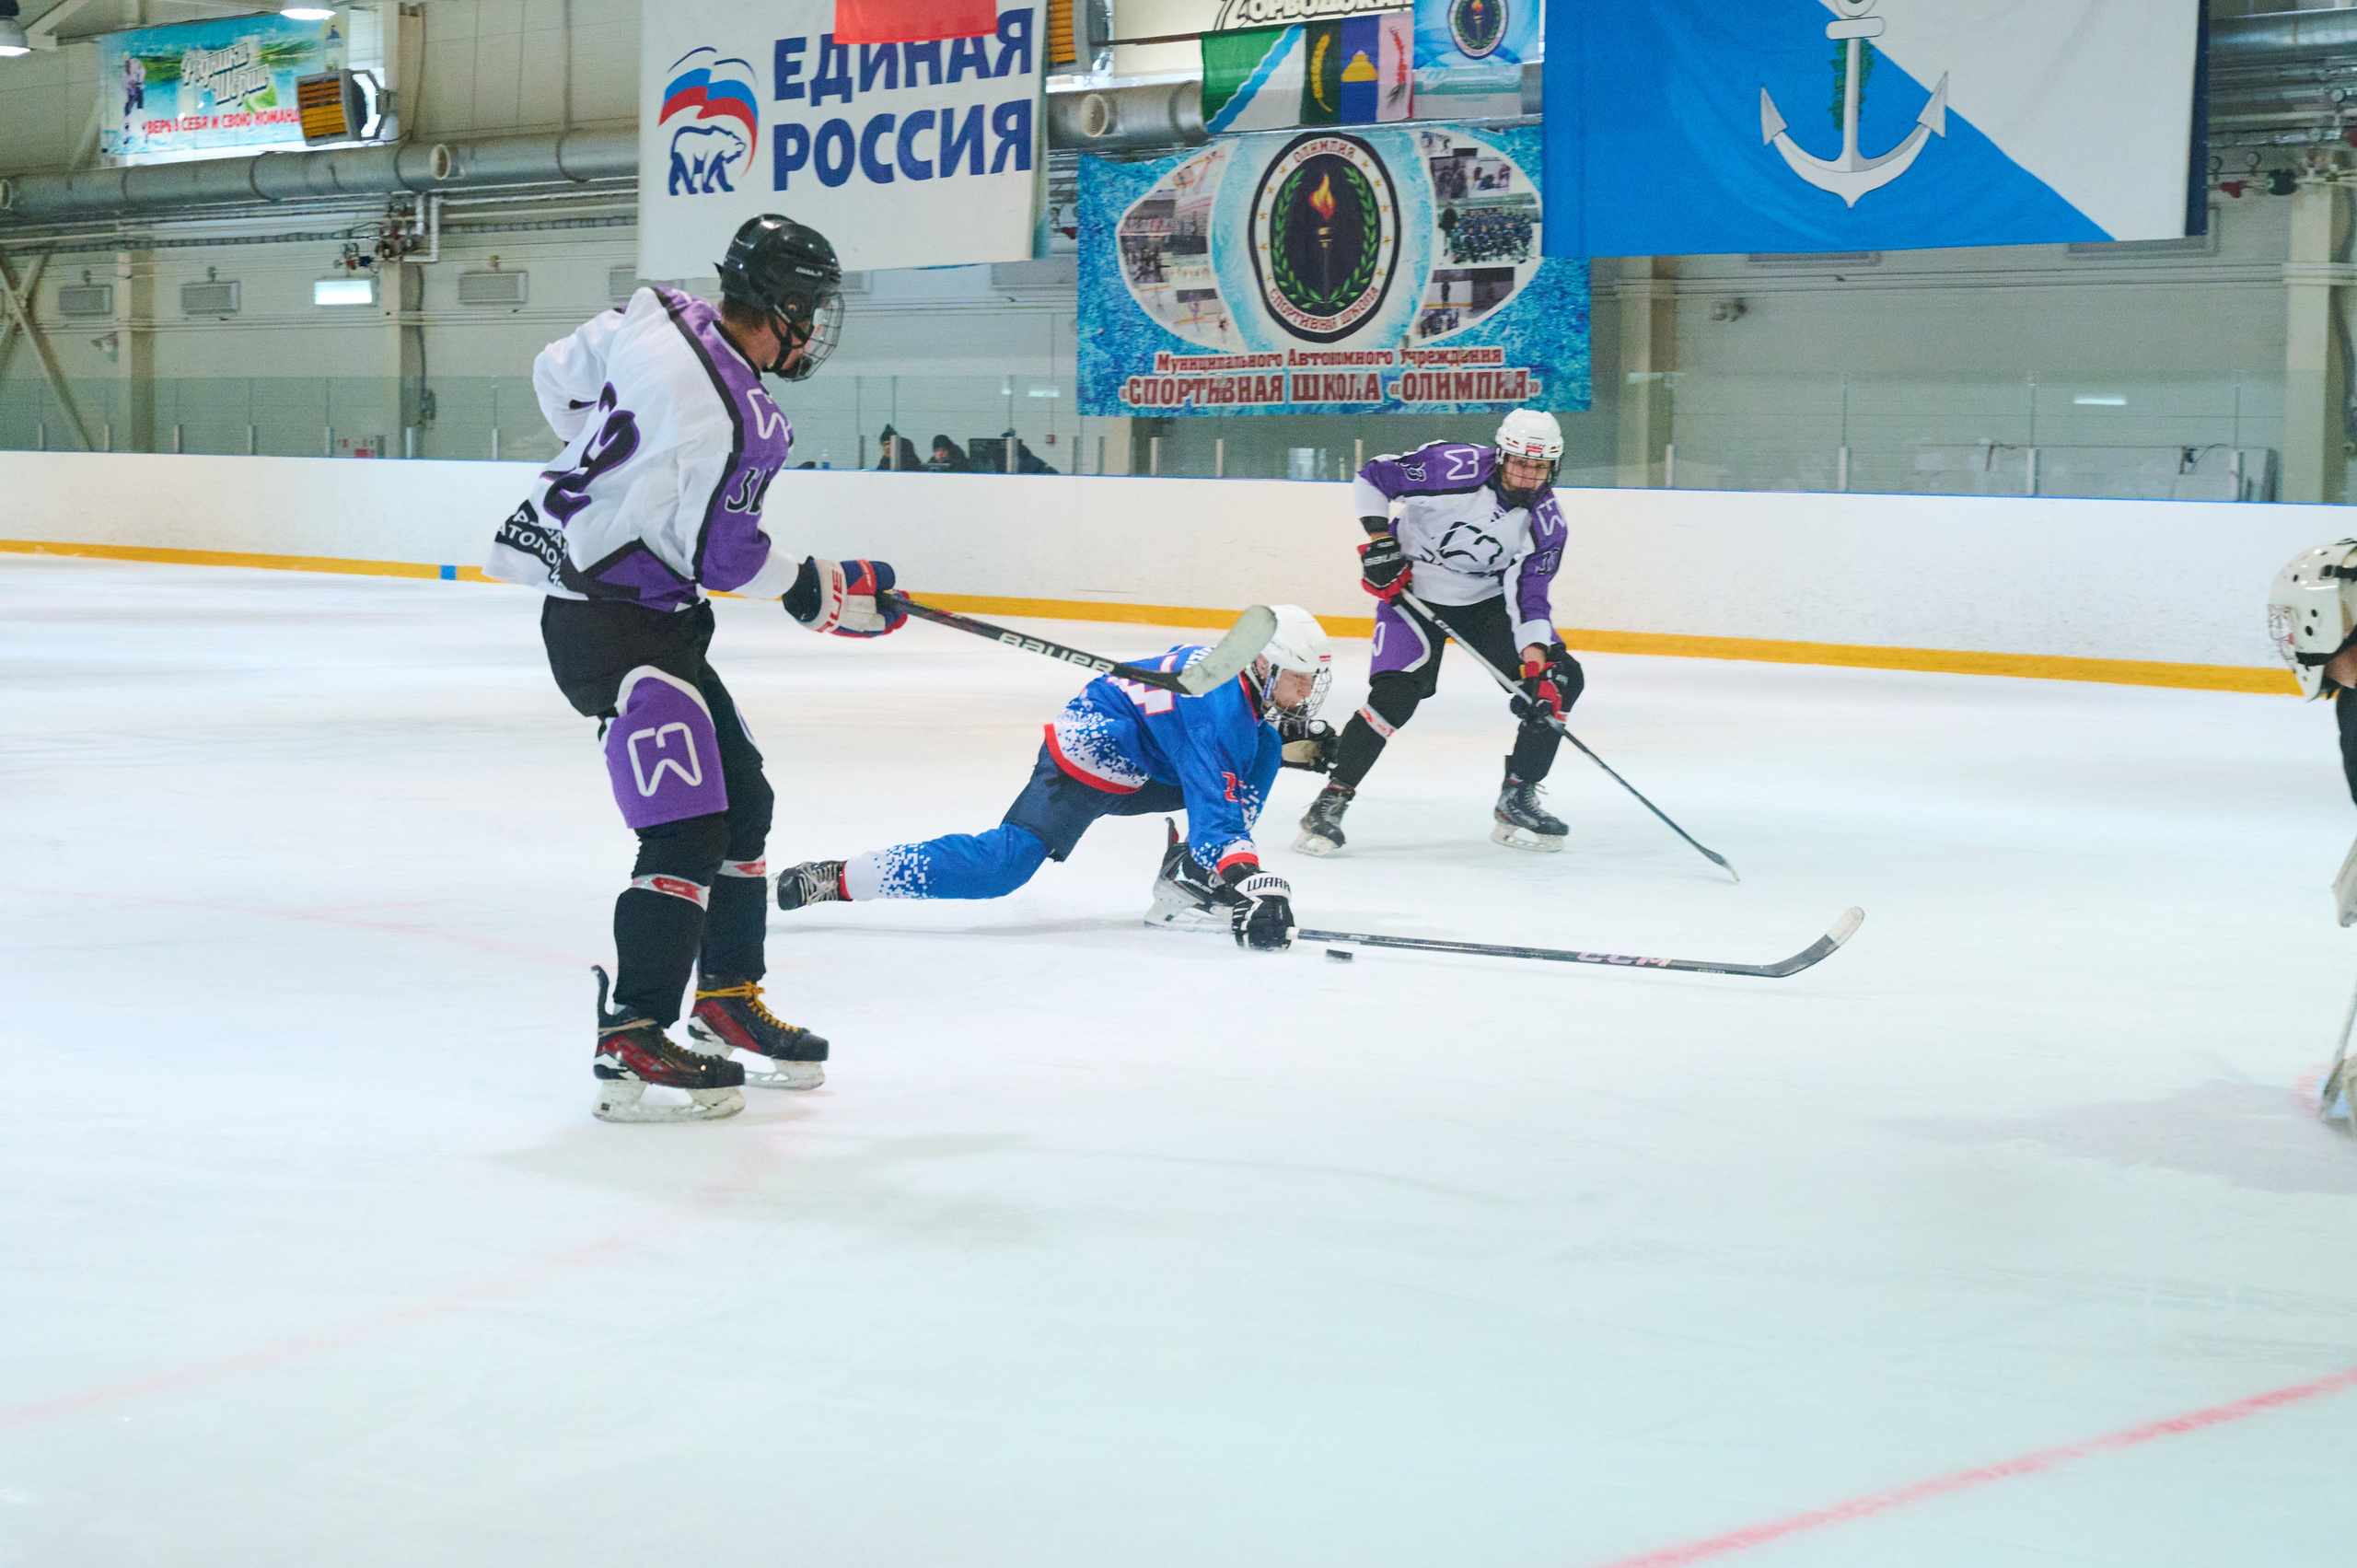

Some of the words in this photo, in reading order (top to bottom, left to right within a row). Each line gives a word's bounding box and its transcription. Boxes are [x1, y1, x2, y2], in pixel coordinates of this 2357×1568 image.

[774, 7, 1033, 107] ЕДИНАЯ
[254, 107, 301, 126] КОМАНД
[773, 99, 1032, 192] РОССИЯ
[1157, 353, 1283, 374] Муниципального
[1288, 348, 1393, 369] Автономного
[1399, 347, 1503, 368] Учреждения
[1293, 372, 1380, 401] ШКОЛА
[1364, 551, 1405, 567] BAUE
[1576, 950, 1673, 968] CCM
